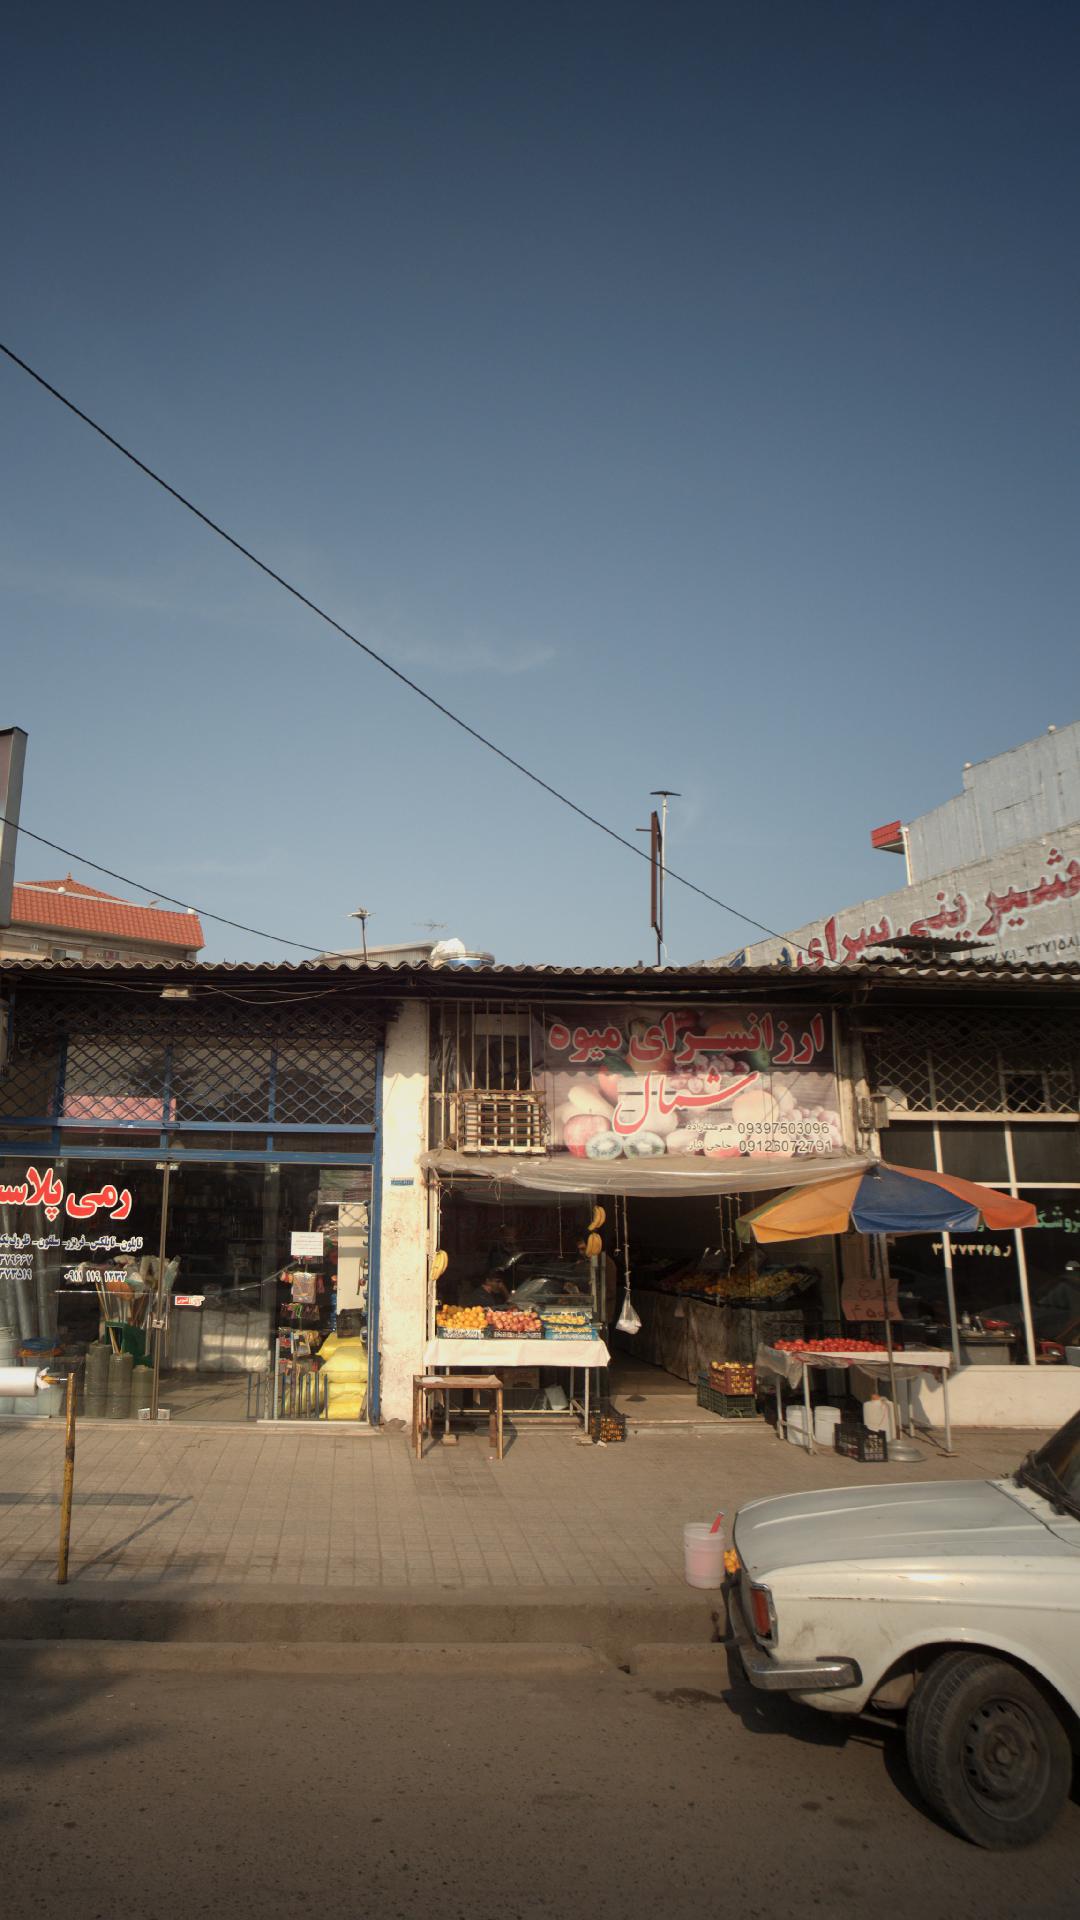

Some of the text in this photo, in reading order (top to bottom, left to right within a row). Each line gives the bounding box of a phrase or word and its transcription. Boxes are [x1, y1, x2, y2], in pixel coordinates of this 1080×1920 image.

[549, 1023, 623, 1063] میوه
[612, 1065, 760, 1136] شمال
[738, 1122, 830, 1134] 09397503096
[66, 1184, 132, 1220] رمی
